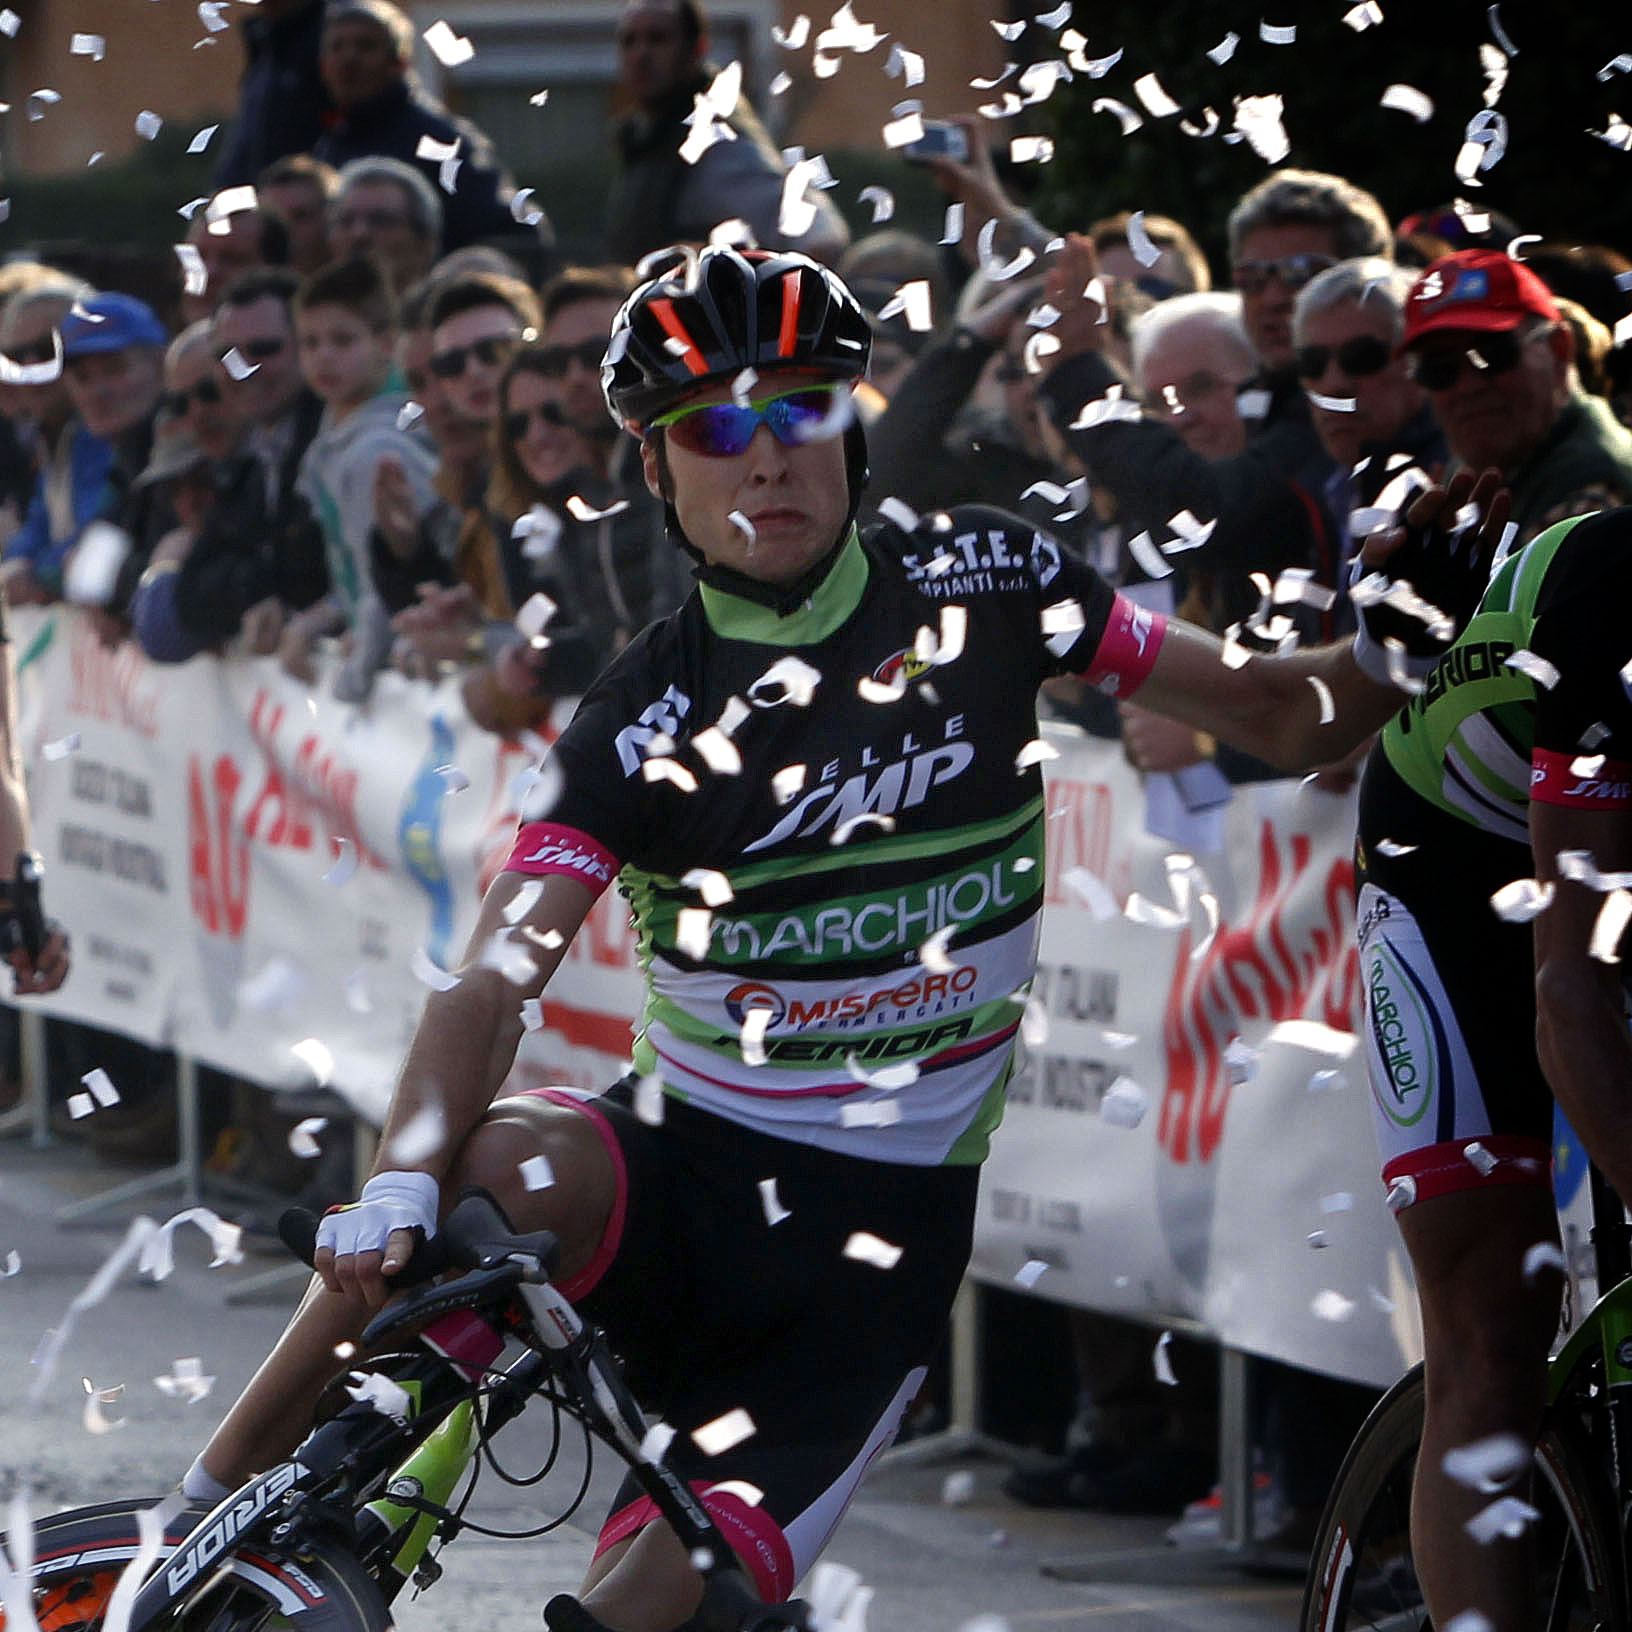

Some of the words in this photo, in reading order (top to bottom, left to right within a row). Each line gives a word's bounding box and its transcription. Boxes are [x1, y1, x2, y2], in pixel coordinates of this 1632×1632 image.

[741, 740, 975, 854] SMP
[819, 712, 966, 783] ELLE
[709, 862, 1015, 960] MARCHIOL
[1368, 956, 1425, 1106] MARCHIOL
[167, 1461, 312, 1596] ERIDA
